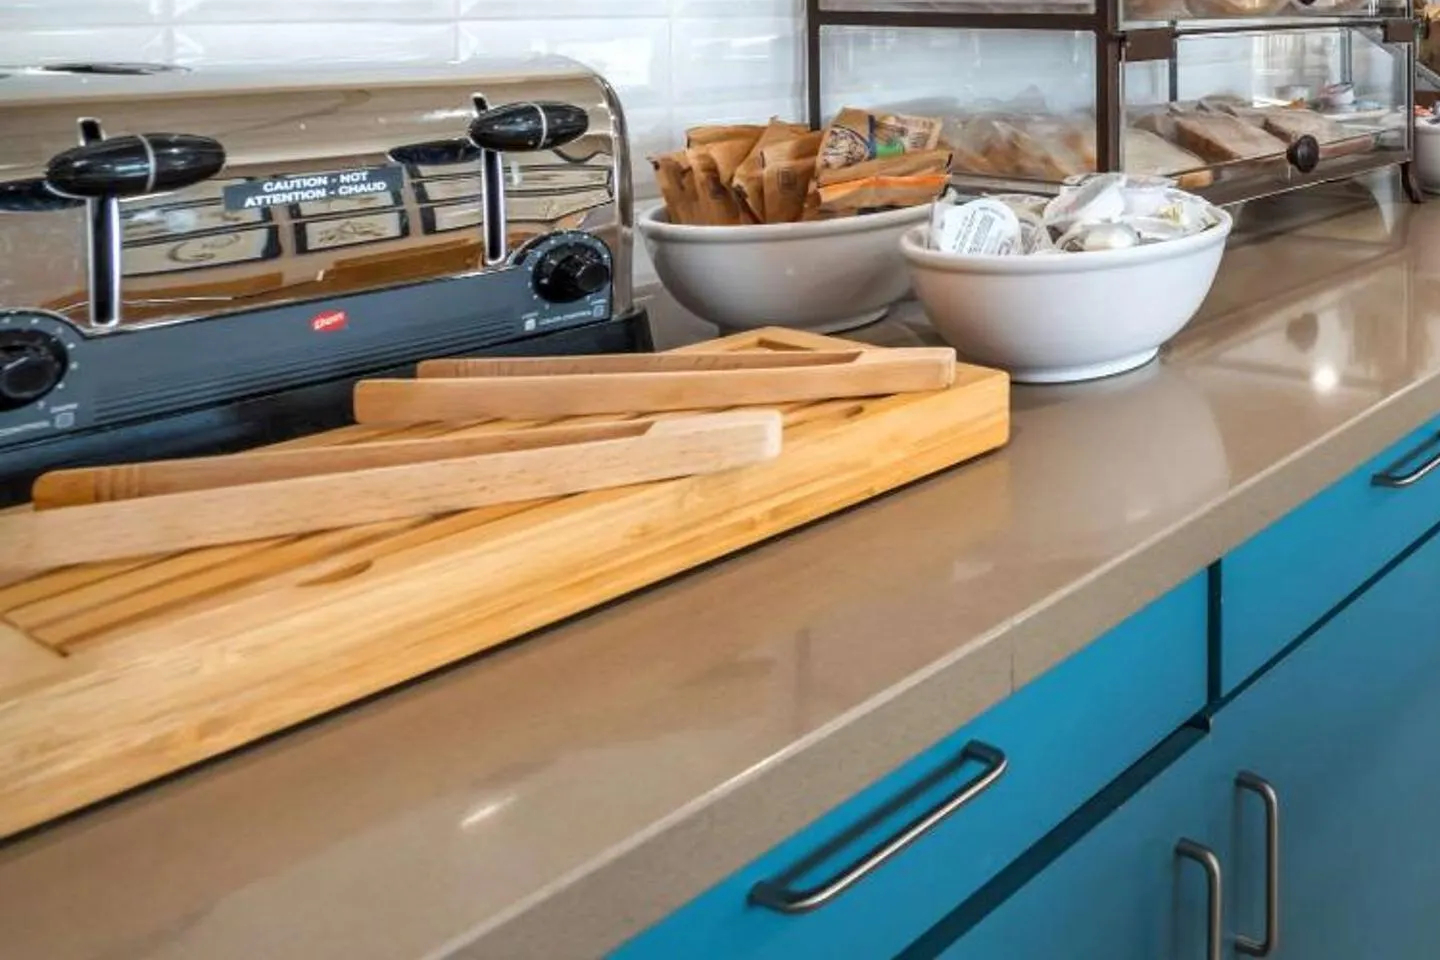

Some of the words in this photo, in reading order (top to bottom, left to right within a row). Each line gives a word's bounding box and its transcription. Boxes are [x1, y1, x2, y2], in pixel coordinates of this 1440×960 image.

[244, 188, 327, 208] ATTENTION
[338, 182, 388, 196] CHAUD
[262, 176, 329, 193] CAUTION
